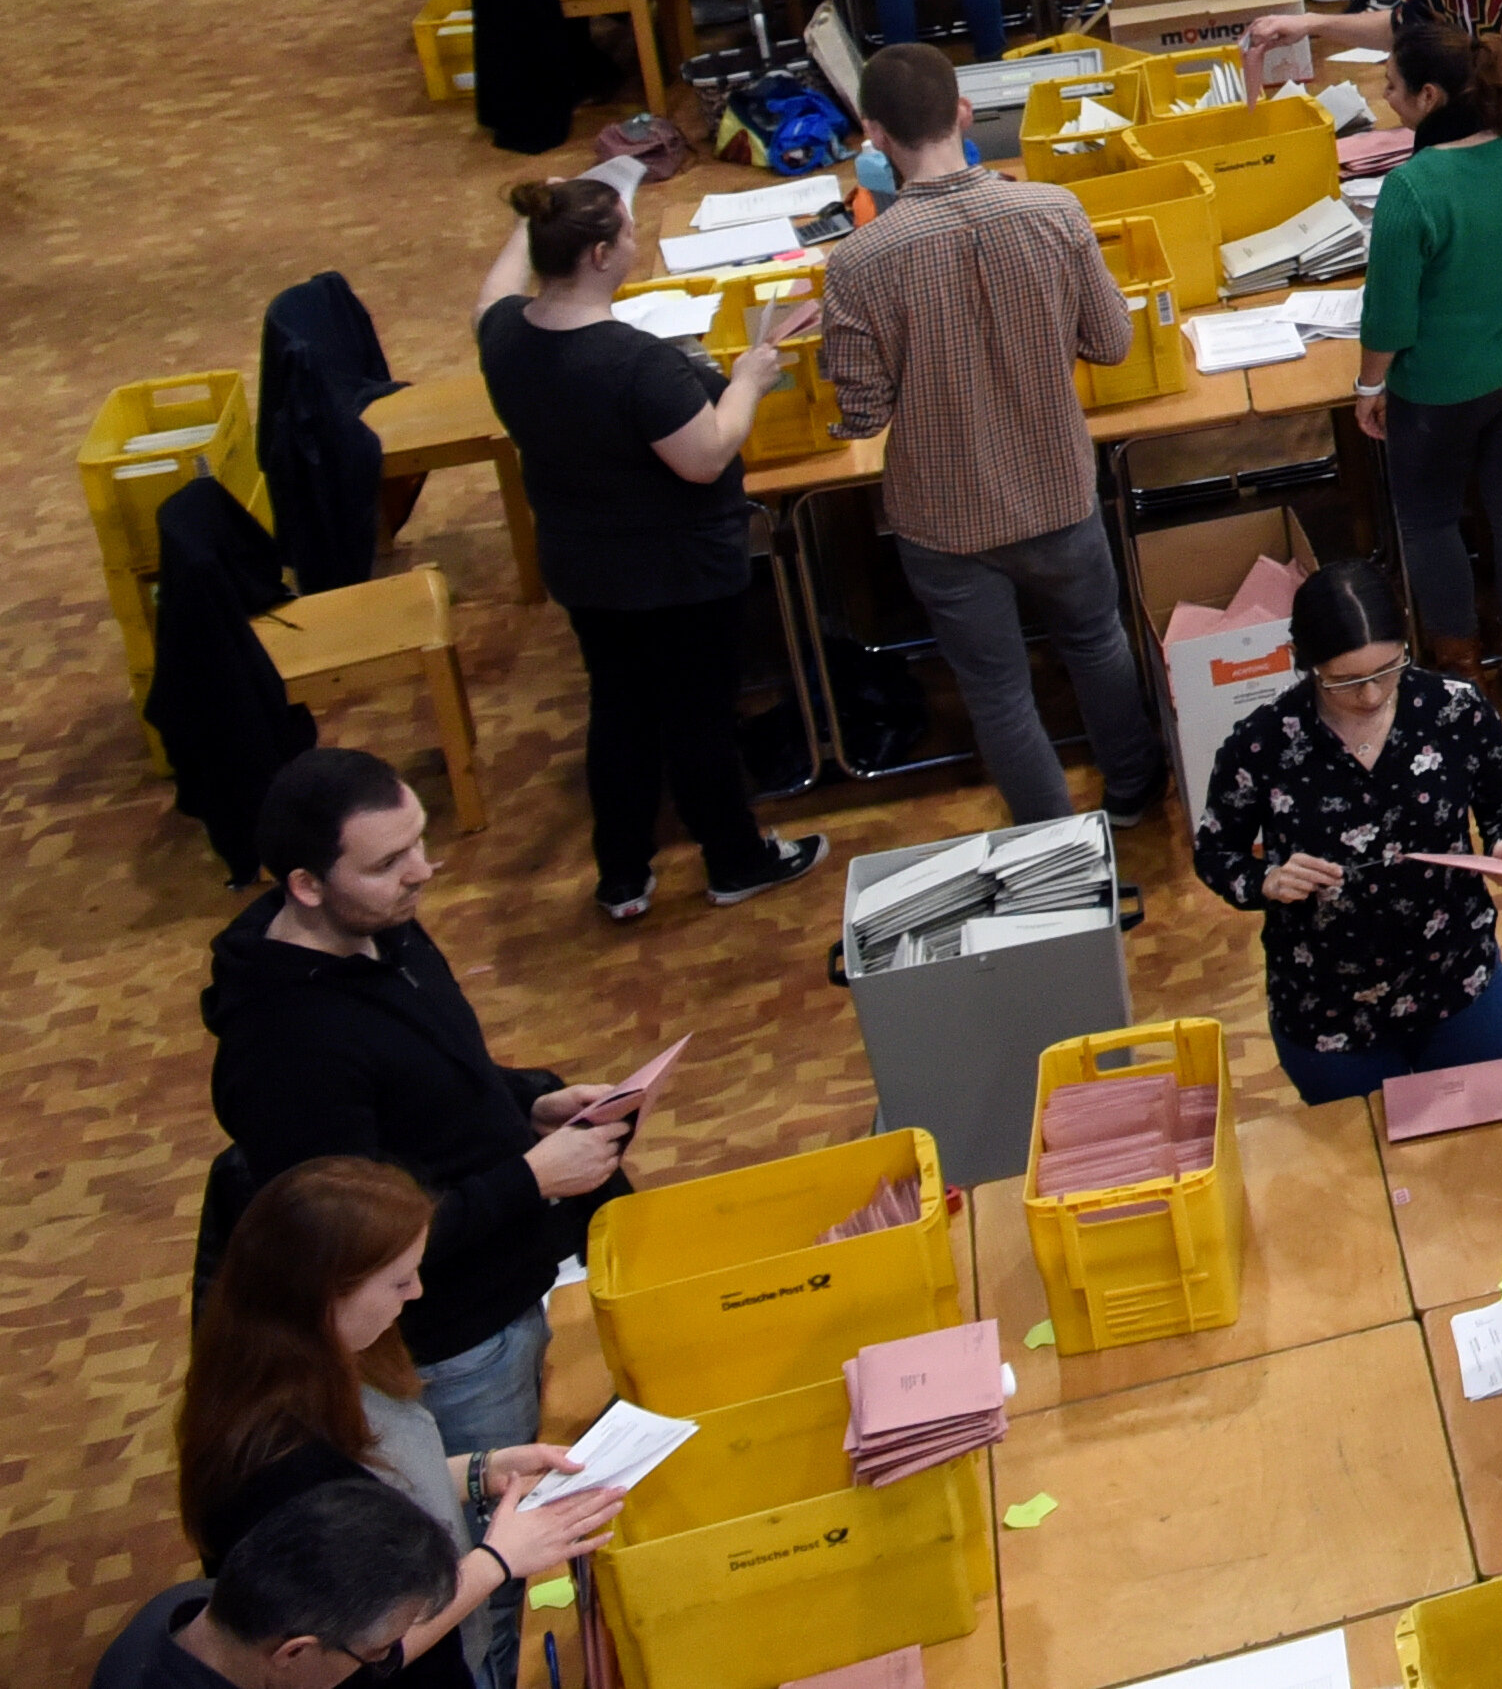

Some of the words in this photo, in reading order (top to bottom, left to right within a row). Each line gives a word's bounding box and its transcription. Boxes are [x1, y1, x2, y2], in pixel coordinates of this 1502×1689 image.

[1161, 15, 1248, 47] moving
[720, 1289, 778, 1312] Deutsche
[778, 1283, 807, 1299] Post
[728, 1548, 790, 1573] Deutsche
[792, 1539, 822, 1556] Post
